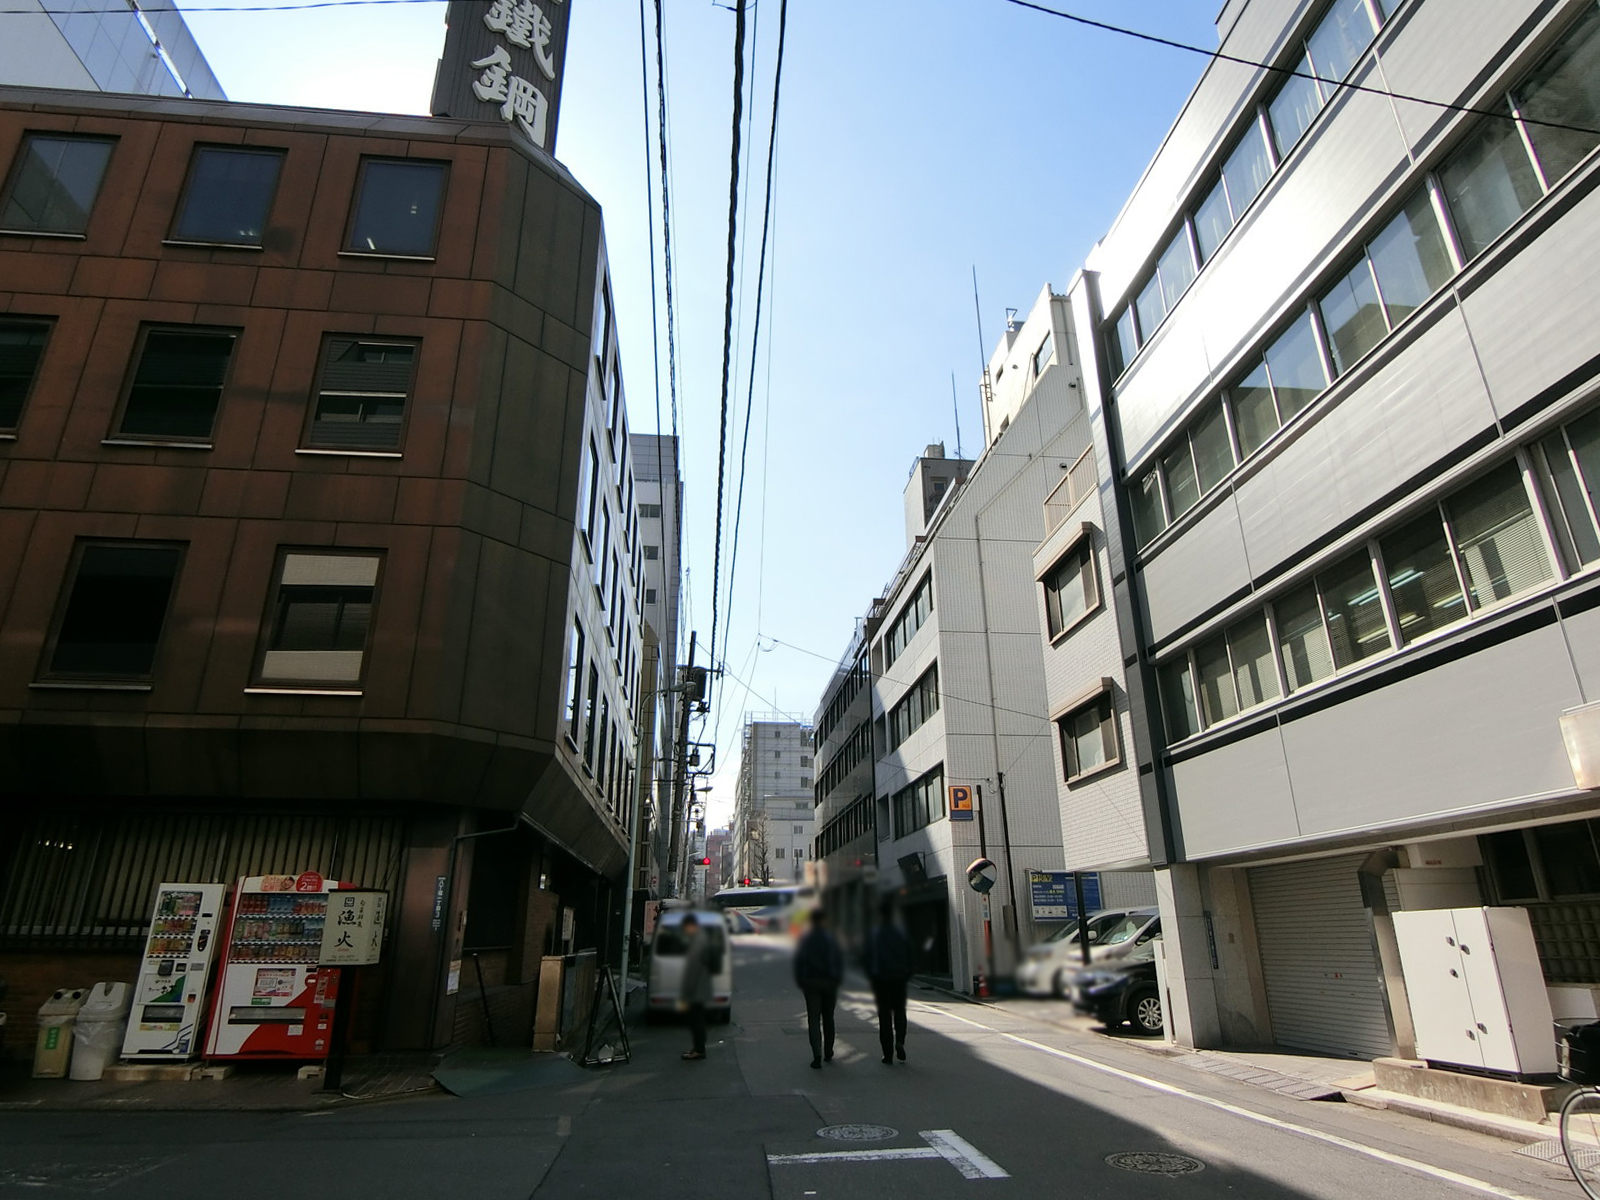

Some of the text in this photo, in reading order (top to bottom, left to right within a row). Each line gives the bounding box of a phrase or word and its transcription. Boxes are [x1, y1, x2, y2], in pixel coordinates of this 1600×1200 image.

[469, 0, 562, 149] 鐵鋼
[953, 788, 968, 808] P
[334, 909, 357, 948] 漁火
